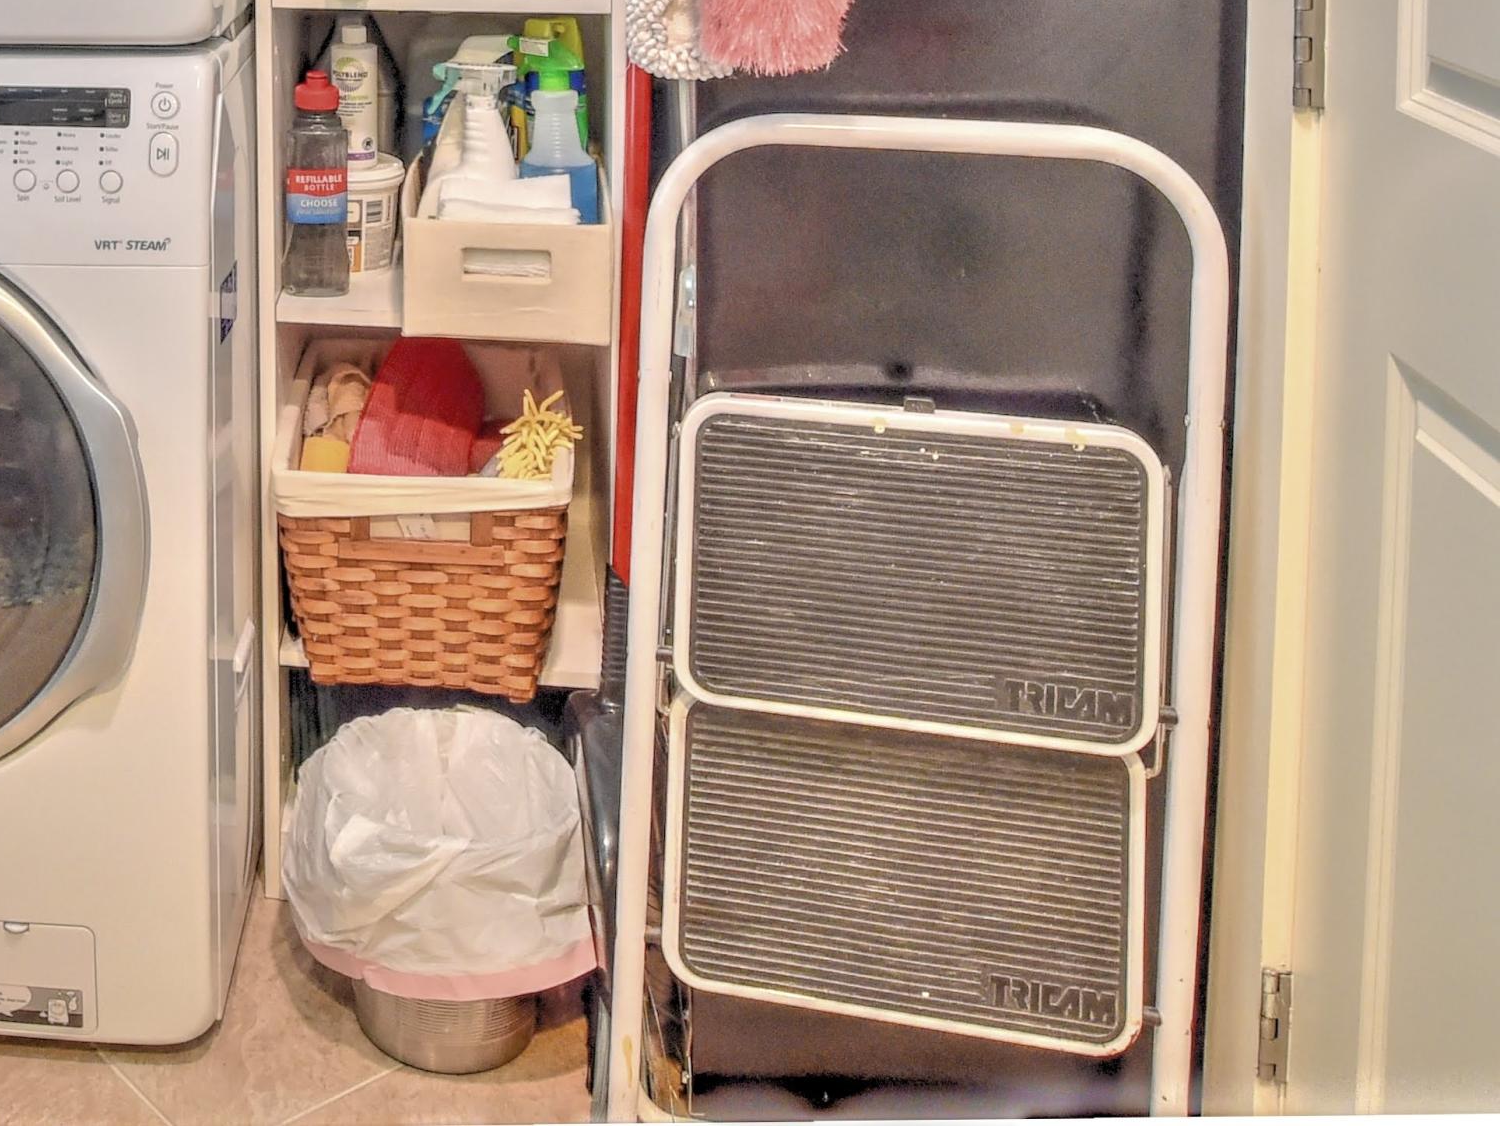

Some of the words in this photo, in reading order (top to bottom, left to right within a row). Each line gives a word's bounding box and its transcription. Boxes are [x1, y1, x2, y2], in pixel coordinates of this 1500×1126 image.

[296, 173, 343, 184] REFILLABLE
[304, 183, 335, 192] BOTTLE
[17, 194, 30, 203] Spin
[101, 195, 121, 204] Signal
[300, 198, 338, 209] CHOOSE
[94, 240, 118, 250] VRT
[125, 239, 168, 251] STEAM
[1004, 678, 1134, 728] TRICAM
[989, 972, 1119, 1028] TRICAM
